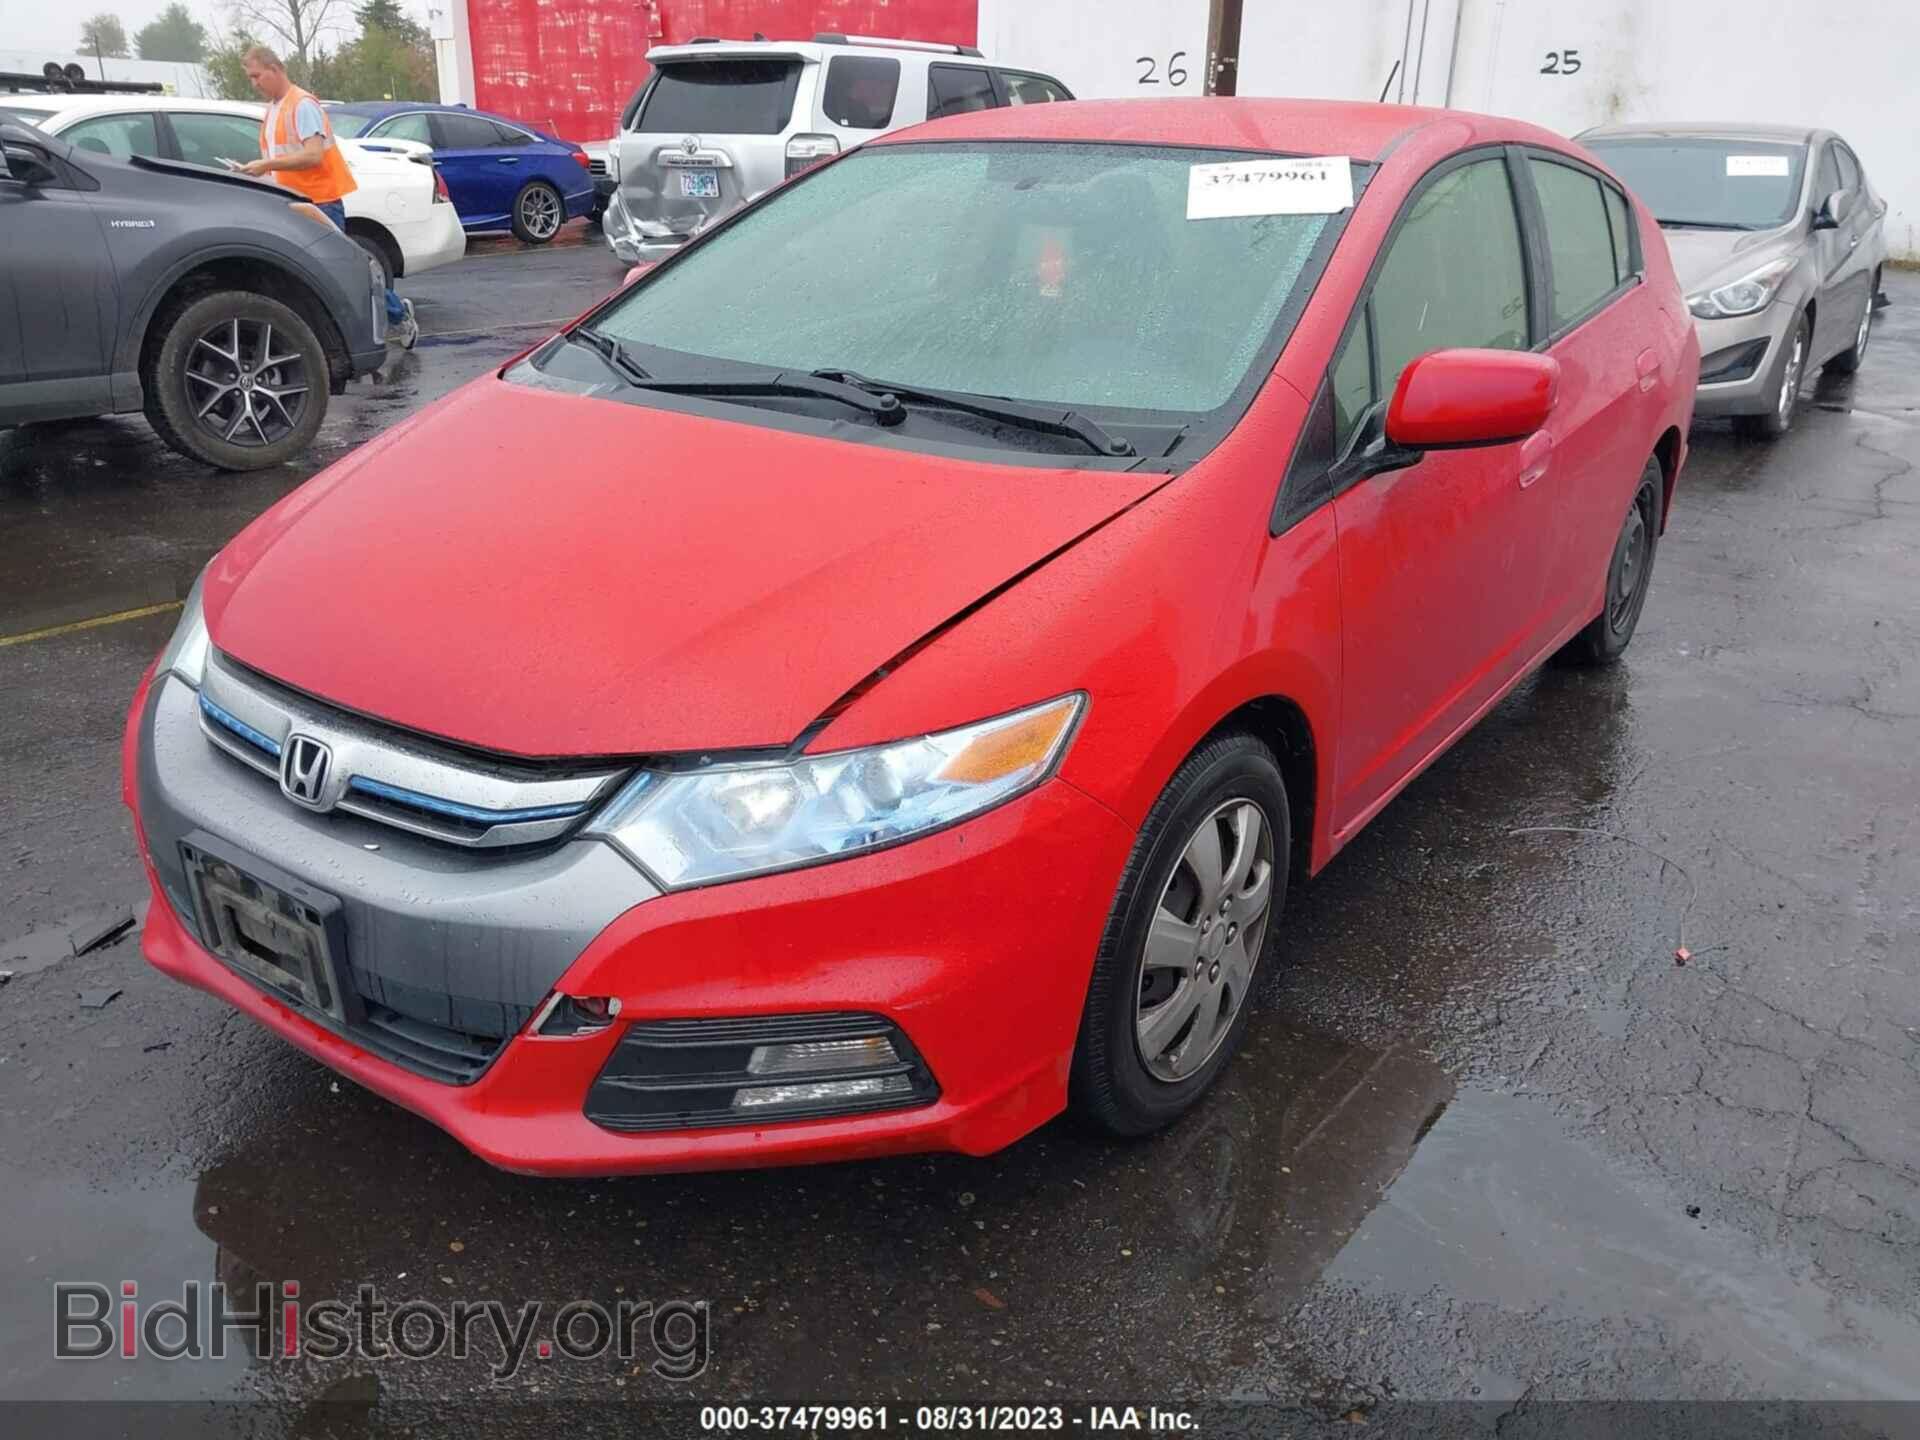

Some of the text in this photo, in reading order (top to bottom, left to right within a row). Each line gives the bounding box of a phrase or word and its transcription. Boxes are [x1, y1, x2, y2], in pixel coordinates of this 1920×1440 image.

[1136, 51, 1187, 86] 26
[1540, 50, 1582, 75] 25
[1209, 170, 1328, 185] 37479961
